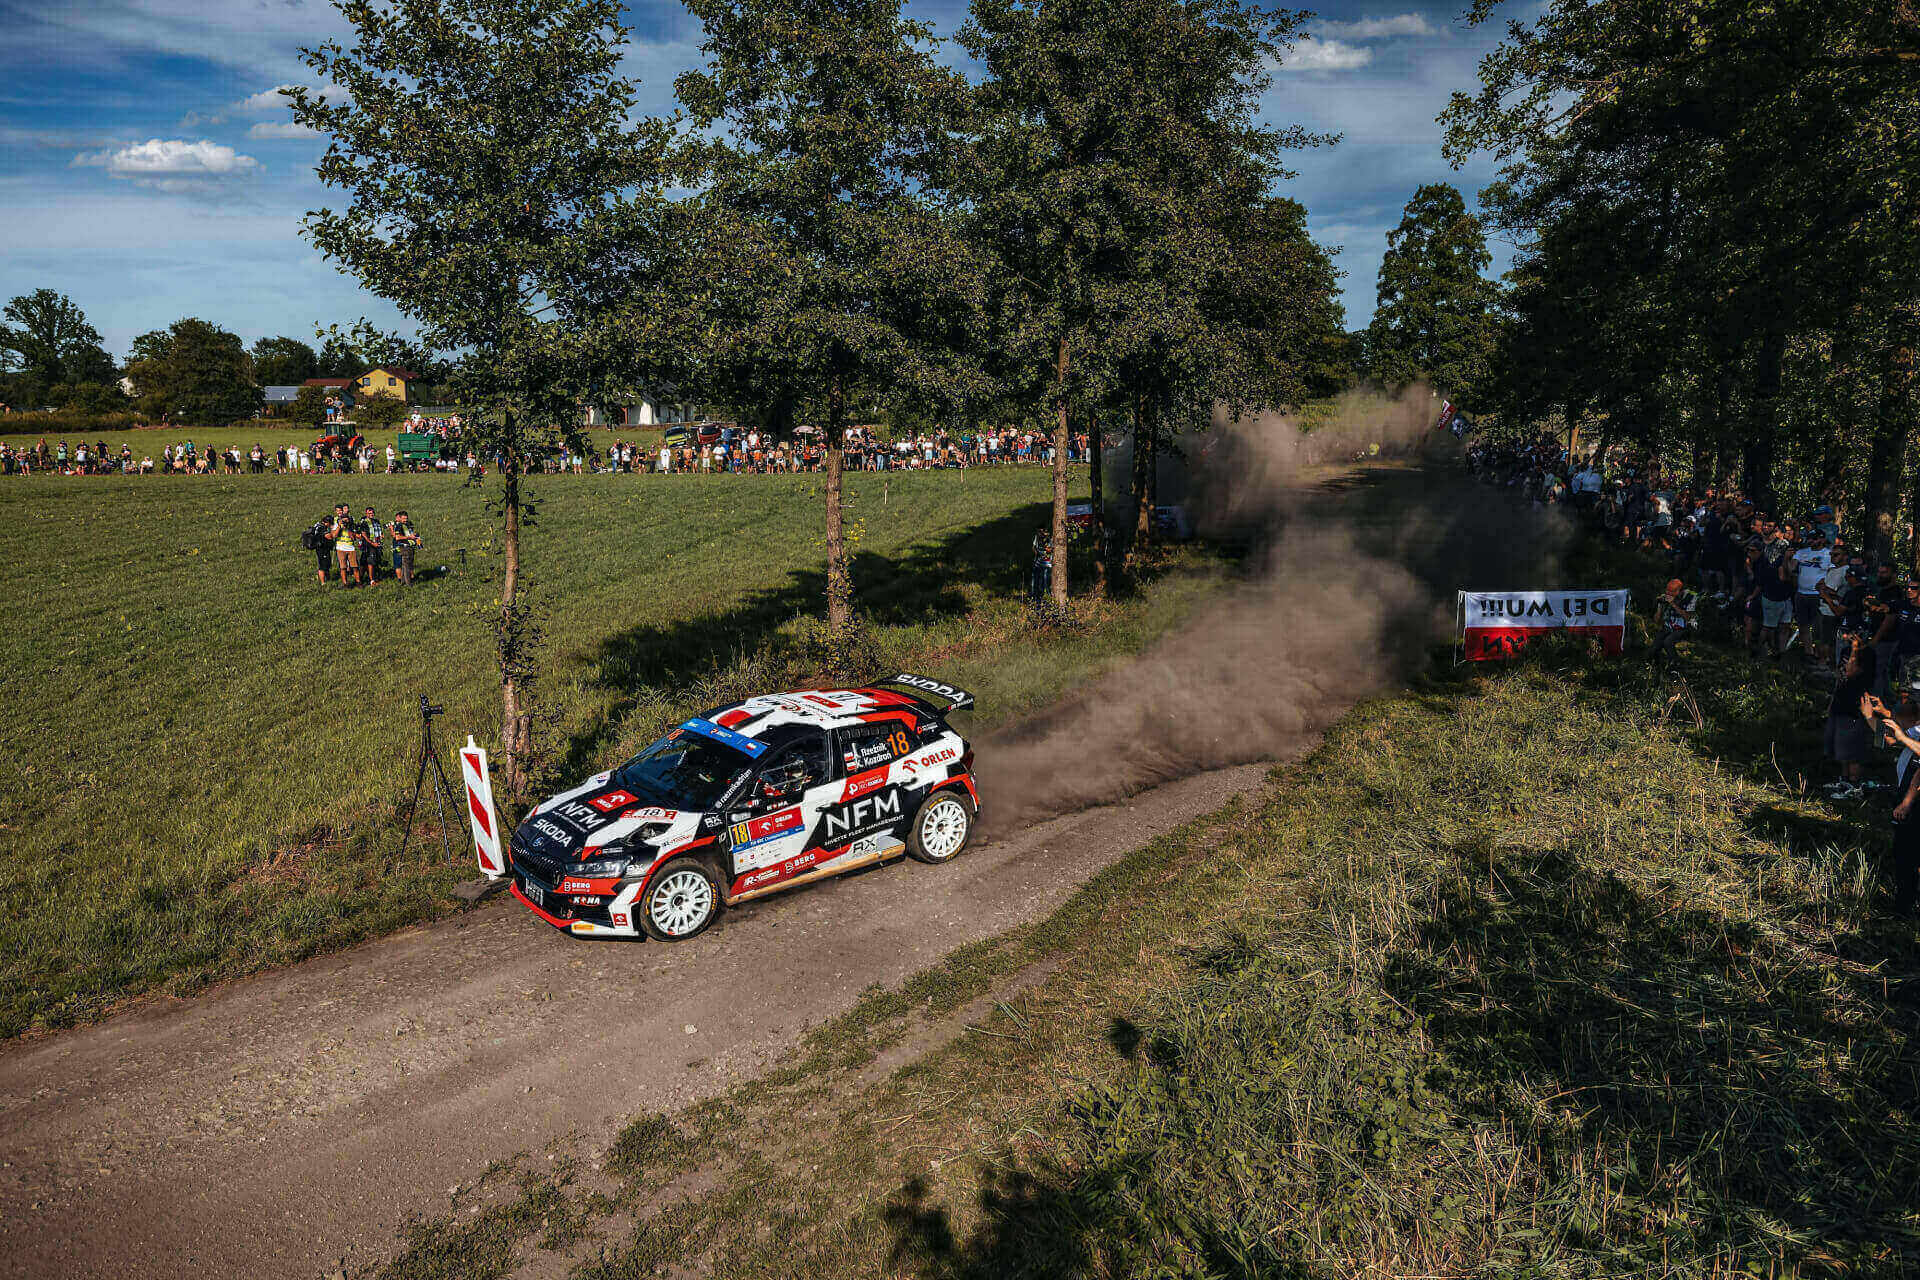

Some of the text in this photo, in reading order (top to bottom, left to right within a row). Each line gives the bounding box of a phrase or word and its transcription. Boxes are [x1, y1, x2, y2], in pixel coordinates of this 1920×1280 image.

[887, 731, 910, 756] 18
[921, 748, 956, 767] ORLEN
[558, 801, 607, 829] NFM
[826, 789, 900, 838] NFM
[732, 823, 749, 845] 18
[793, 853, 815, 866] BERG
